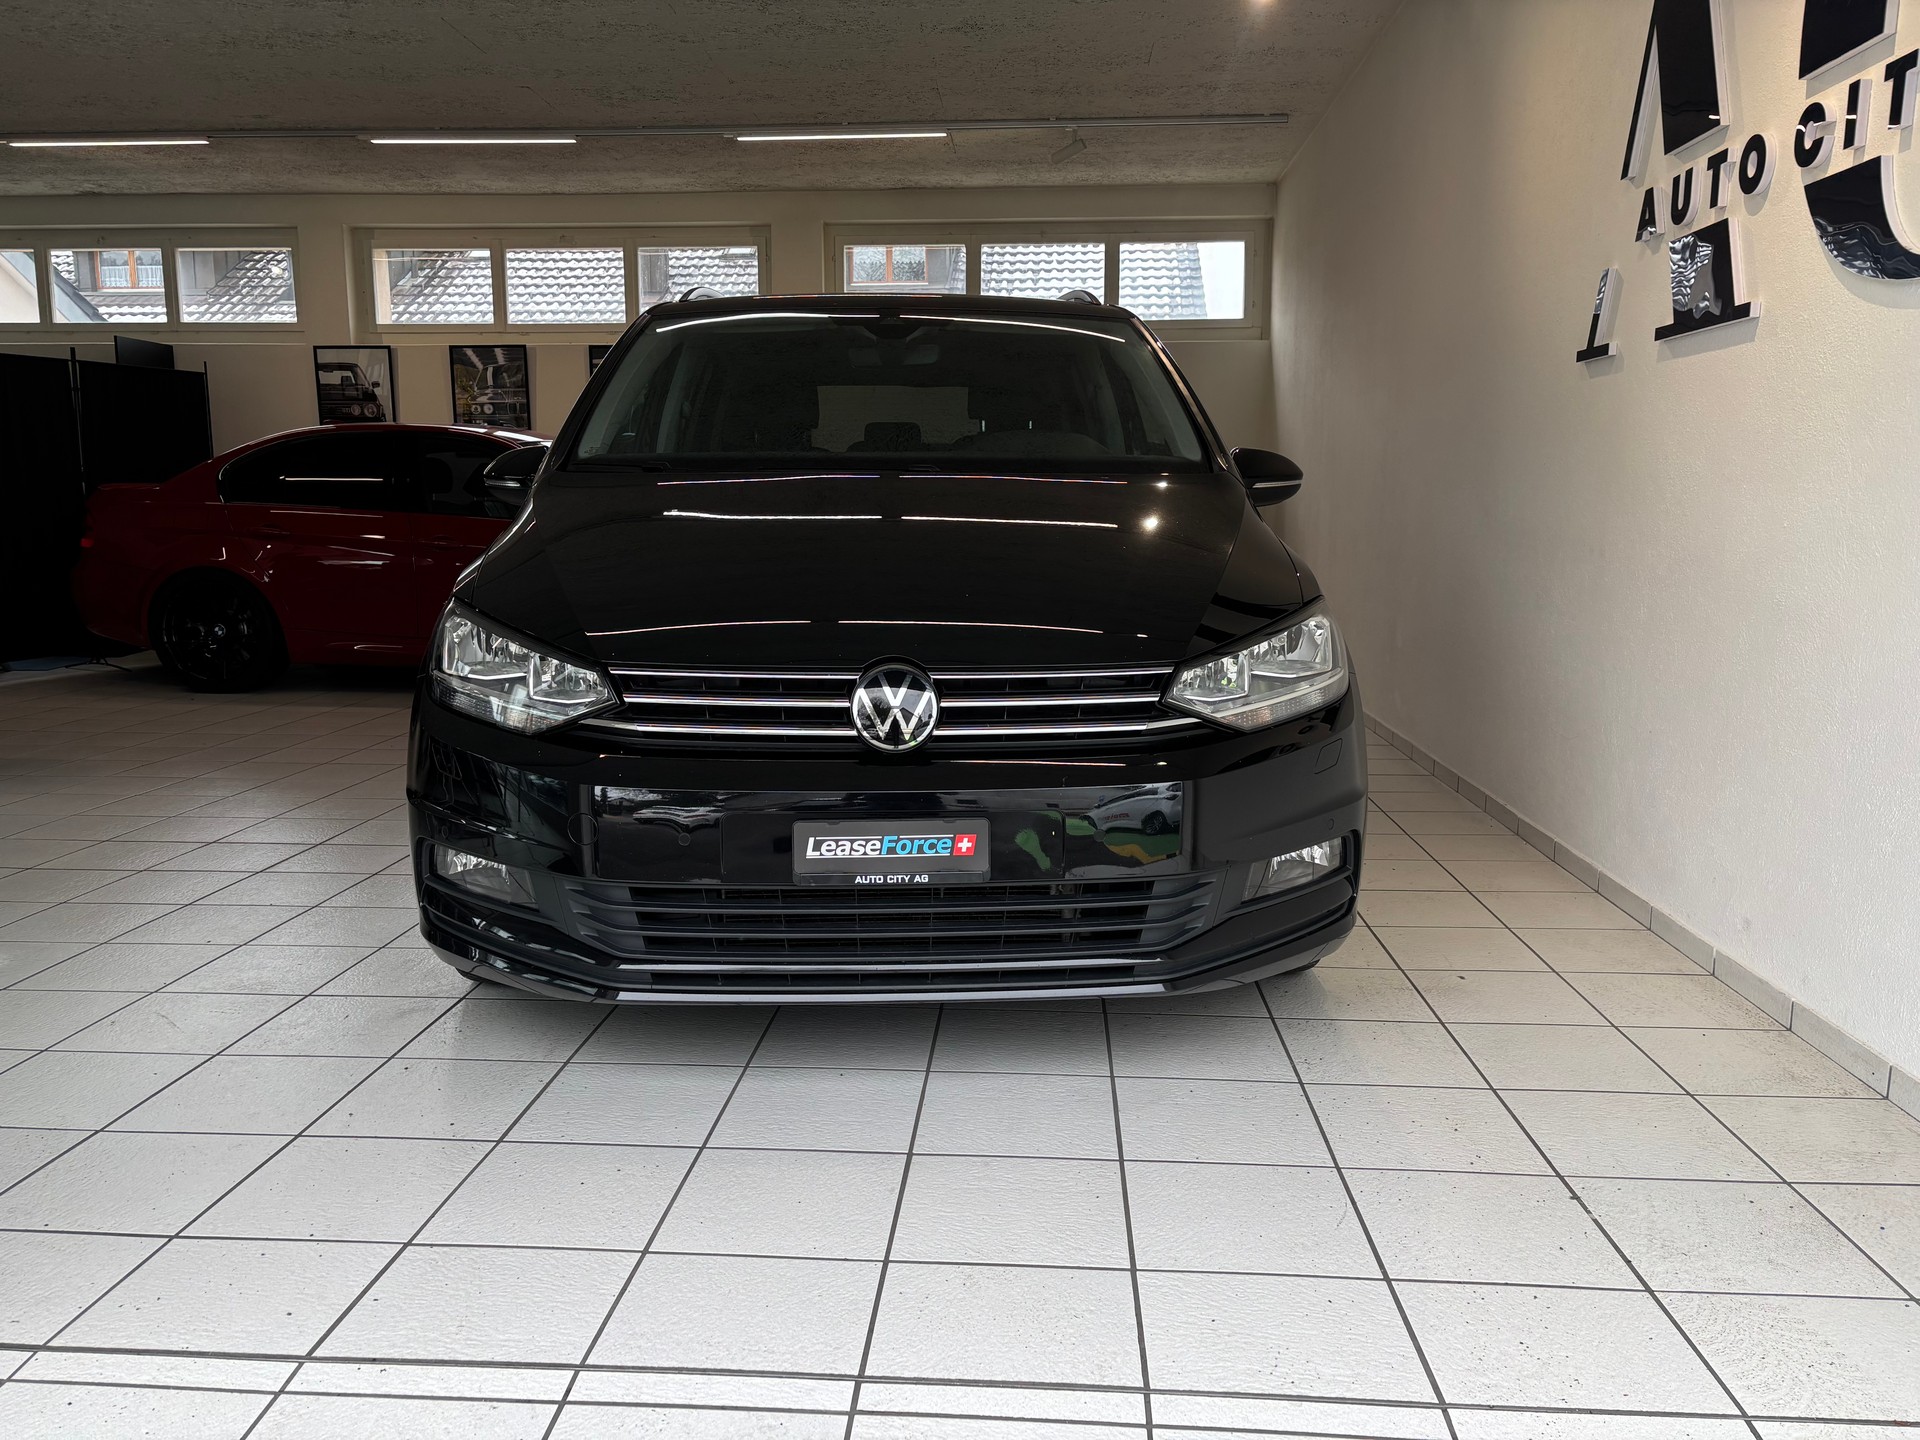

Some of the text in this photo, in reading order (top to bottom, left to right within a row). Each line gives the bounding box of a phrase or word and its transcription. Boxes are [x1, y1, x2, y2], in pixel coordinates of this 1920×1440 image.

[1635, 133, 1770, 243] AUTO
[806, 836, 953, 857] LeaseForce
[855, 874, 929, 884] AUTO CITY AG
